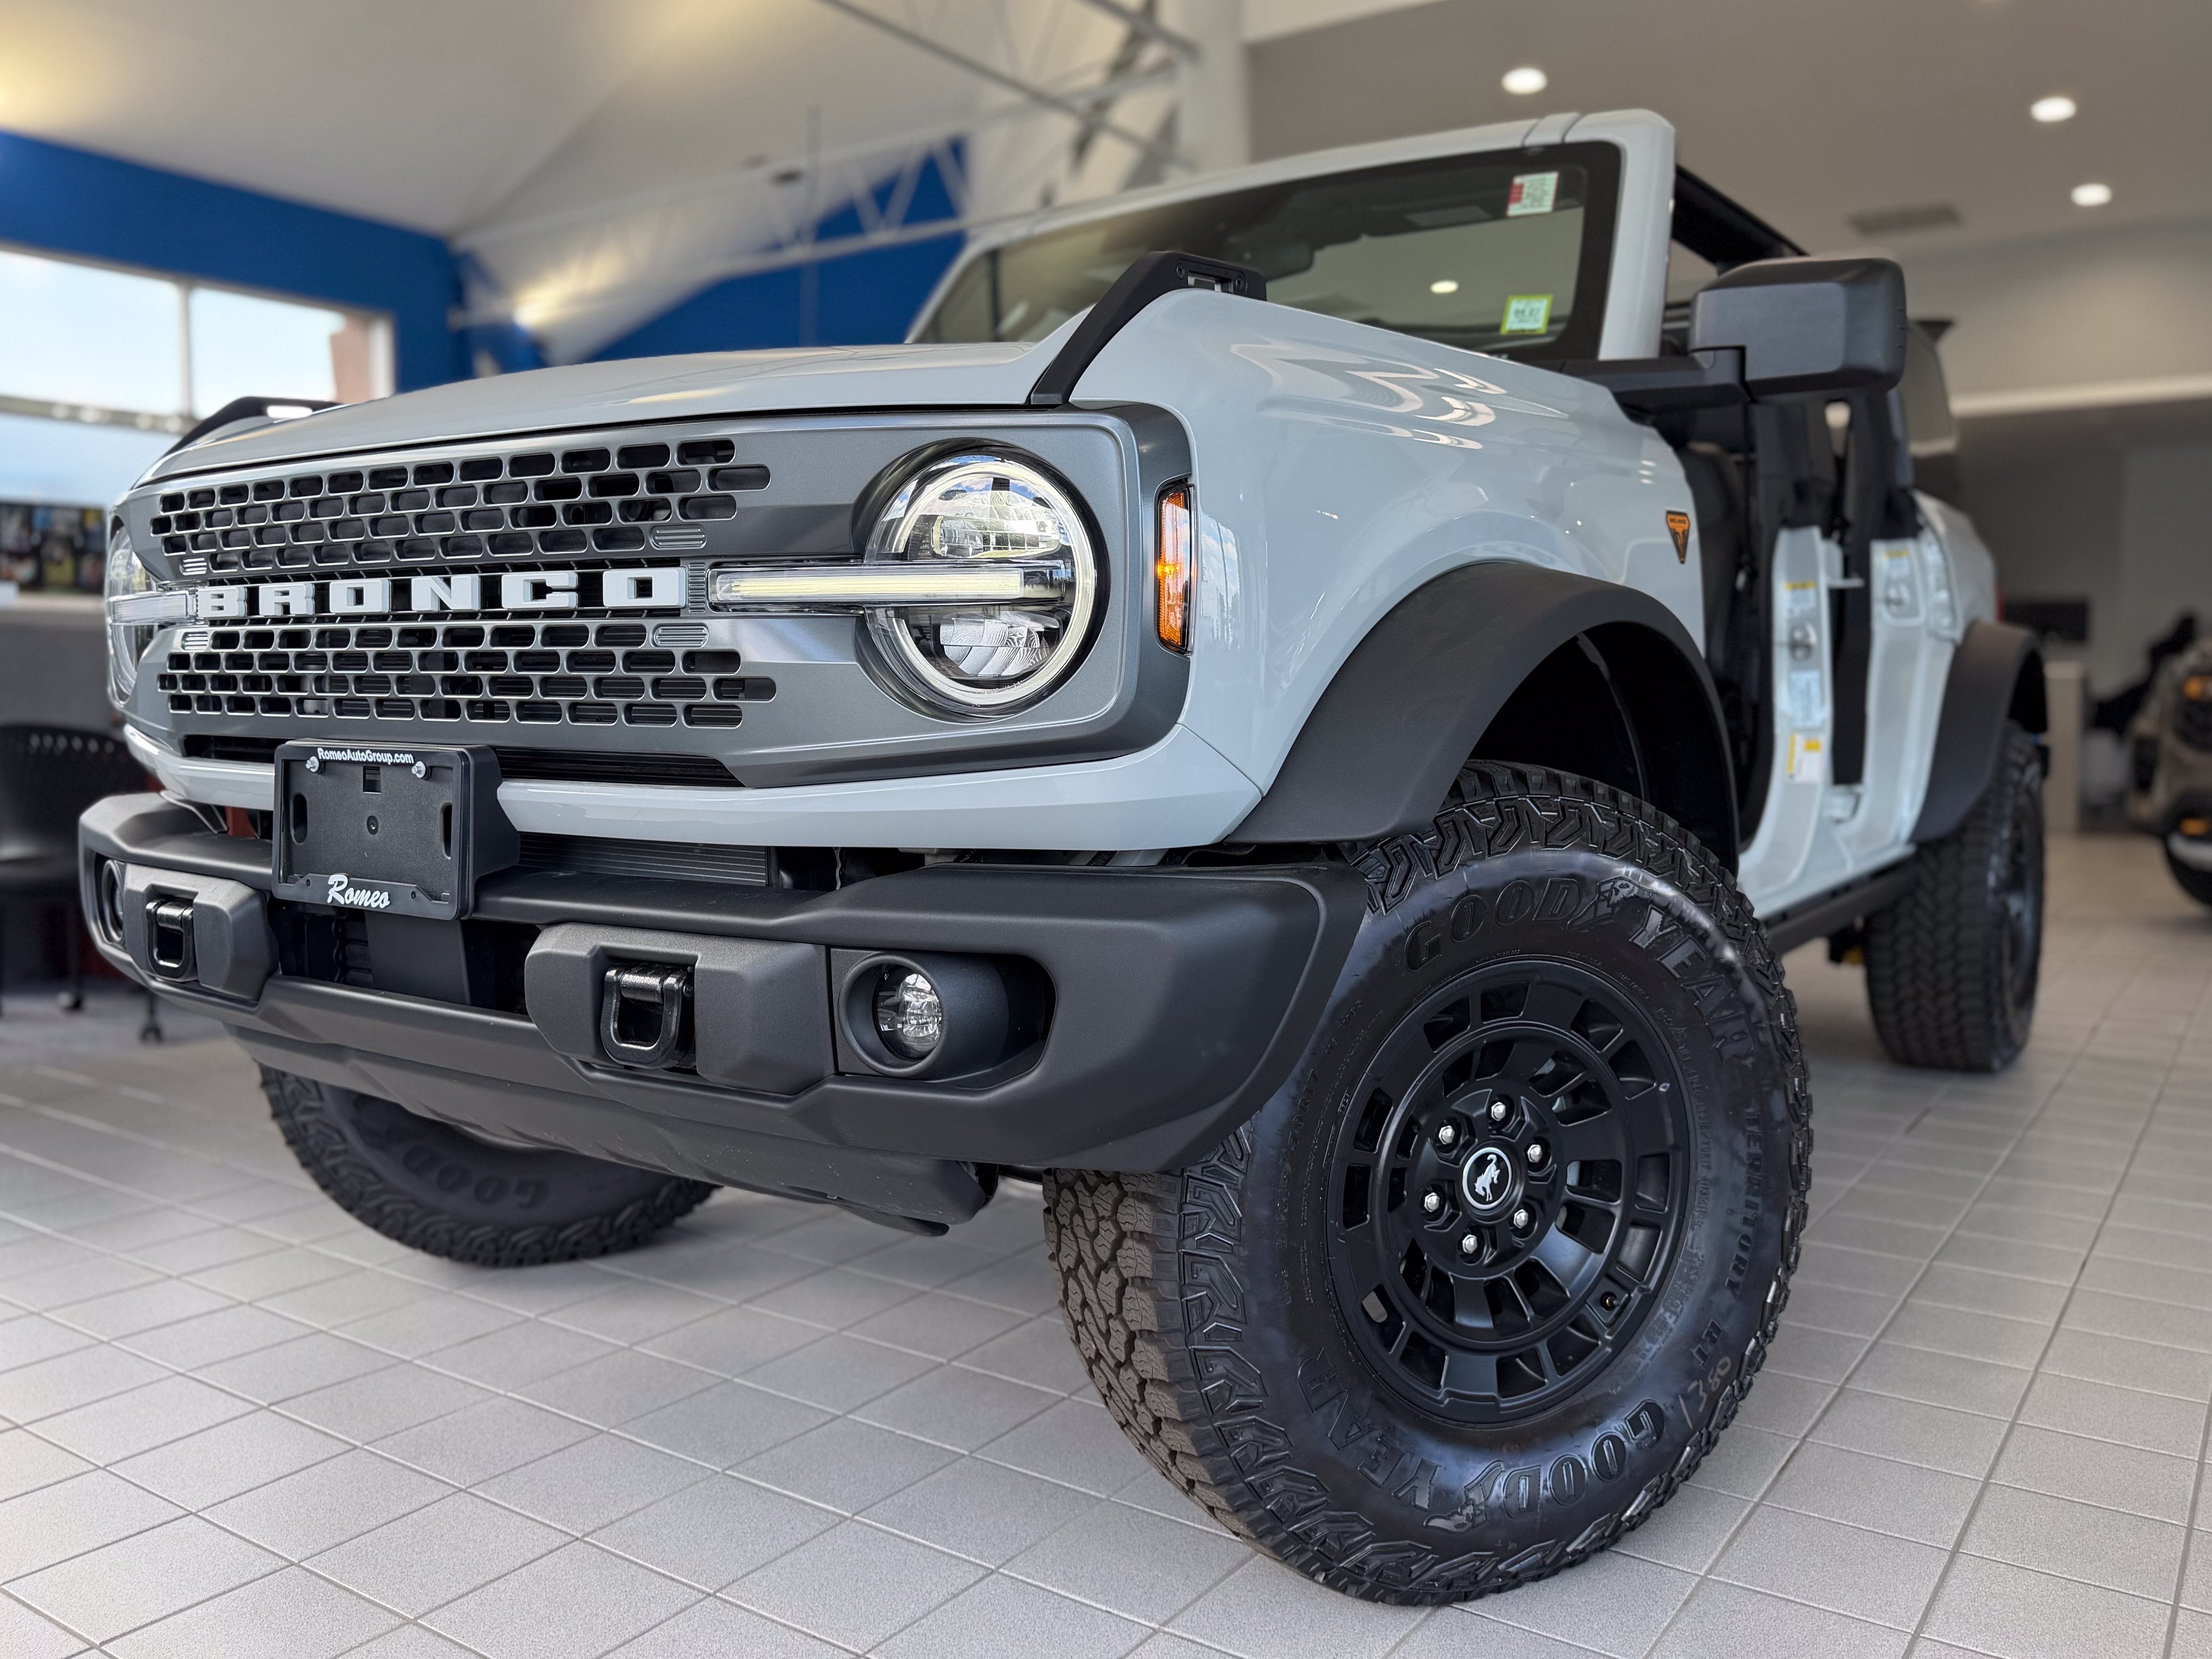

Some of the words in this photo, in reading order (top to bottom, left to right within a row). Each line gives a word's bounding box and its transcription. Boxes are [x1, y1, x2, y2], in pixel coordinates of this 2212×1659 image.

[198, 566, 687, 619] BRONCO
[317, 748, 414, 765] RomeoAutoGroup.com
[327, 874, 390, 908] Romeo
[1725, 1107, 1762, 1302] TERRITORY
[1678, 1355, 1732, 1429] 1380
